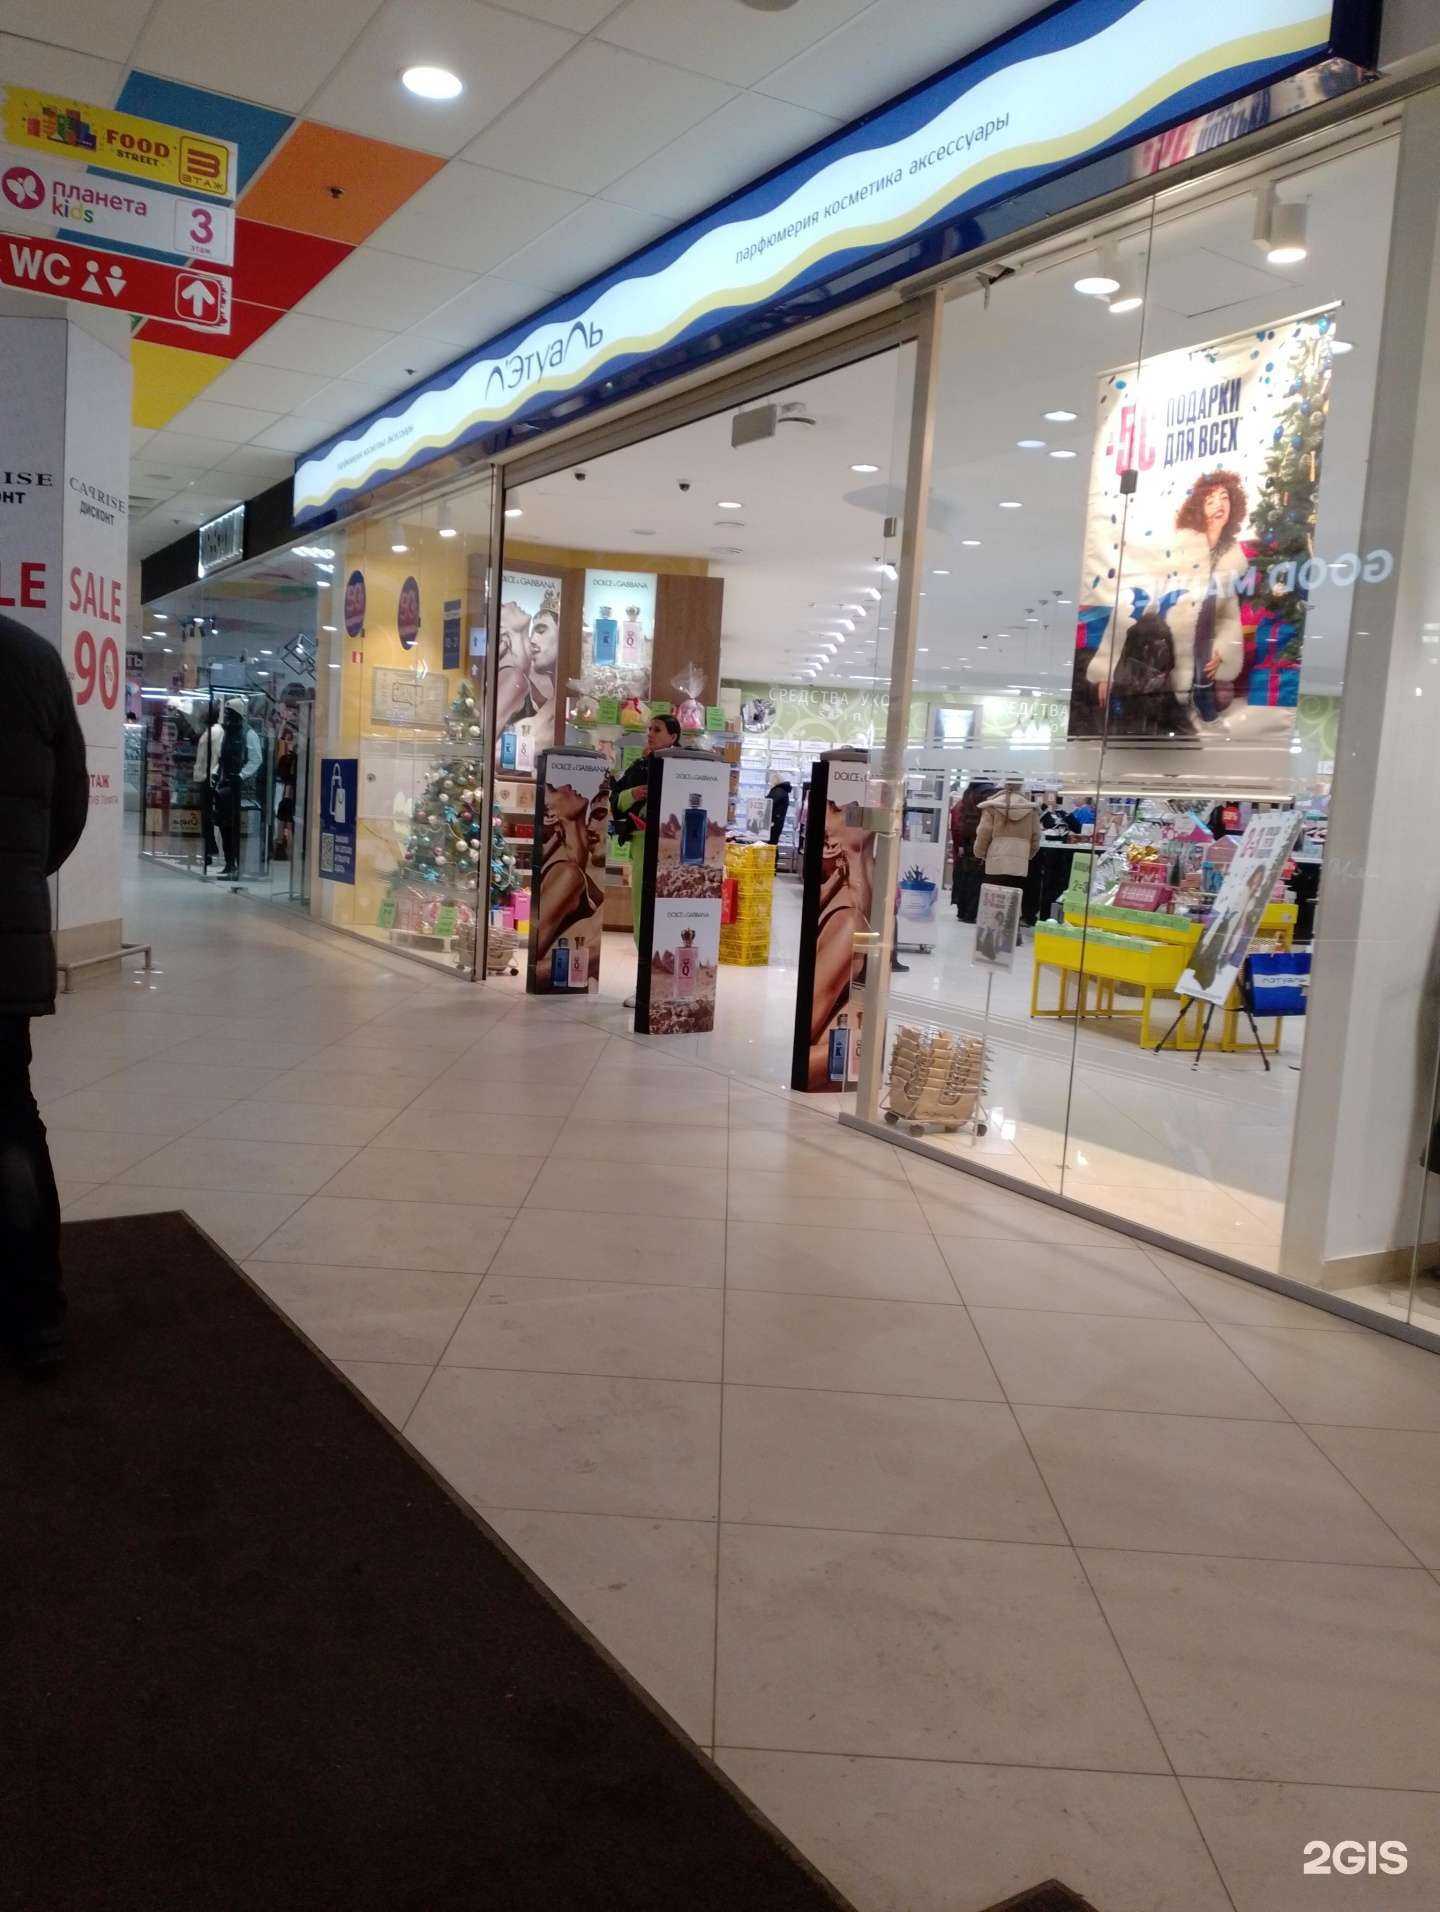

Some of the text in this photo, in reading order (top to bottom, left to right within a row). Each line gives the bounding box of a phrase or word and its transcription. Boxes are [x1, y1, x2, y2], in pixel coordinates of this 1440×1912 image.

[106, 129, 170, 157] FOOD
[116, 149, 160, 166] STREET
[187, 148, 220, 178] 3
[181, 174, 225, 192] ЭТАЖ
[735, 112, 1010, 265] парфюмерия косметика аксессуары
[51, 196, 94, 223] kids
[52, 180, 148, 217] планета
[190, 208, 214, 244] 3
[9, 243, 71, 287] WC
[1166, 376, 1243, 428] ПОДАРКИ
[1163, 428, 1196, 470] ДЛЯ
[0, 471, 53, 488] ISE
[0, 491, 26, 504] НТ
[80, 499, 115, 526] ДИСКОНТ
[69, 565, 122, 625] SALE
[74, 630, 119, 710] 90
[768, 688, 849, 706] СРЕДСТВА
[90, 774, 110, 788] ТАЖ
